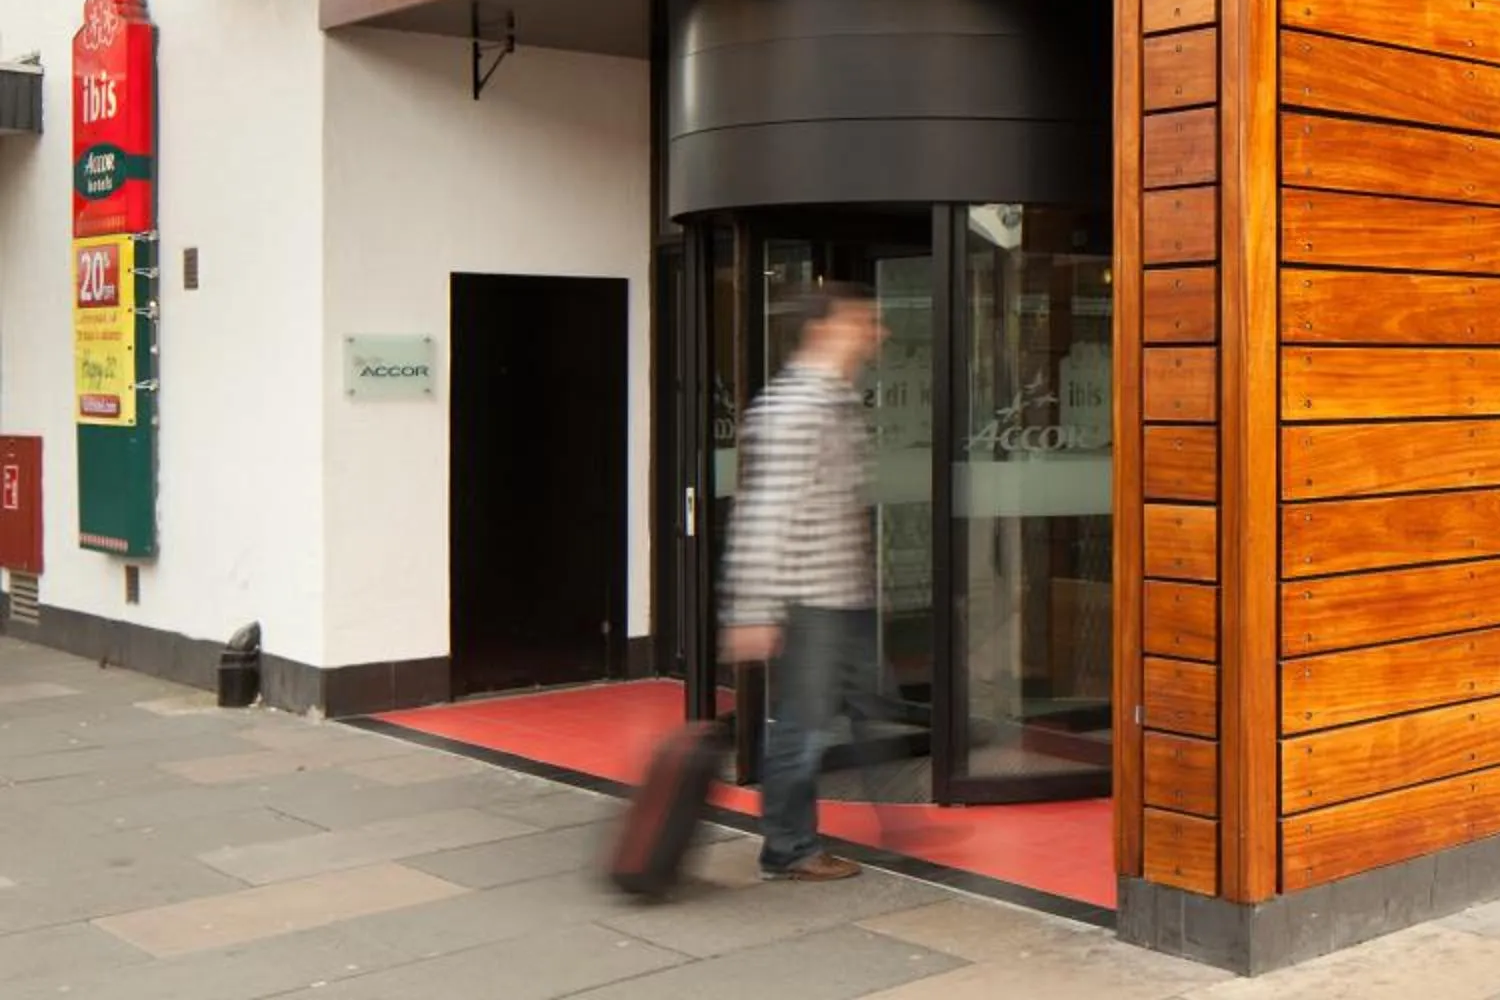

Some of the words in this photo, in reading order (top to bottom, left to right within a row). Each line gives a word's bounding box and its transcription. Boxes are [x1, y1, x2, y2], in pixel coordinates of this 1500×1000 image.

[83, 70, 117, 124] ibis
[87, 176, 113, 193] hotels
[360, 365, 429, 377] ACCOR
